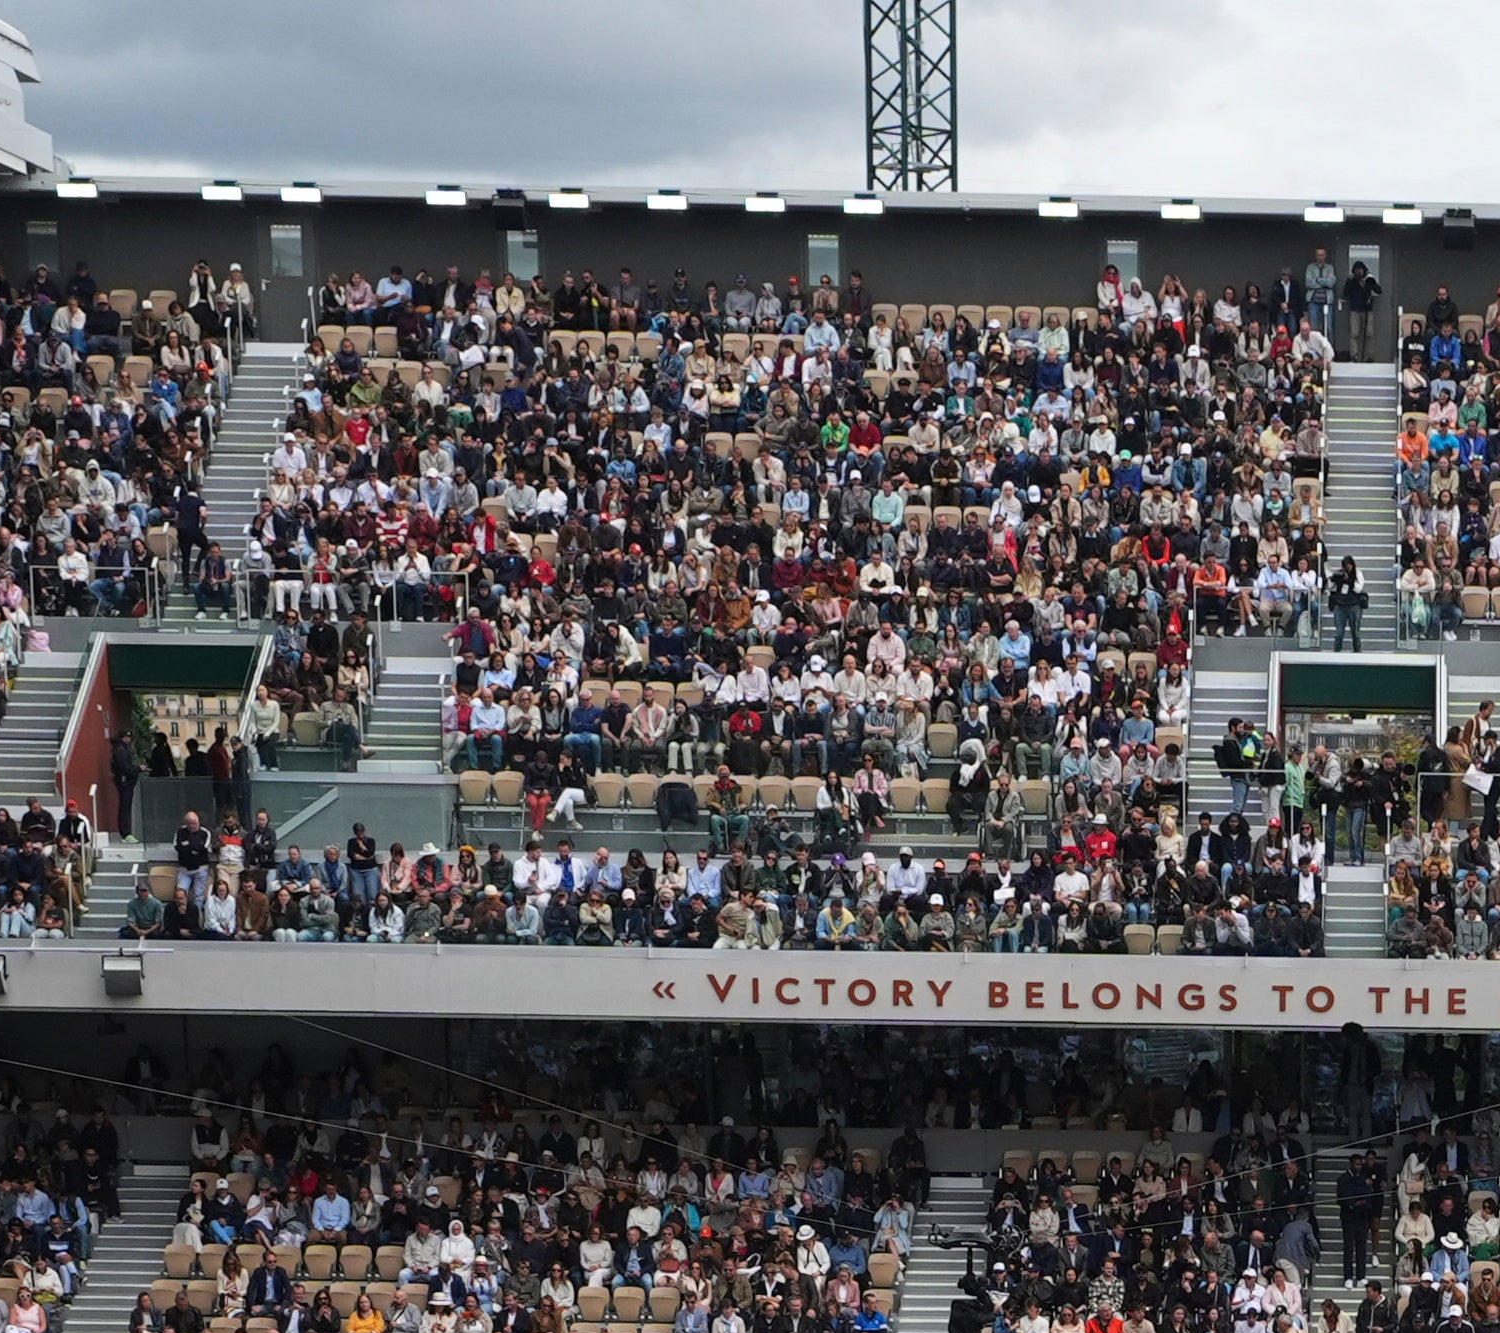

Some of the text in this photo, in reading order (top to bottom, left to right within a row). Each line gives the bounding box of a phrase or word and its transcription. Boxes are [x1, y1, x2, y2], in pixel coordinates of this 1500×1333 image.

[706, 974, 953, 1008] VICTORY
[988, 981, 1238, 1012] BELONGS
[1271, 984, 1336, 1014] TO
[1368, 987, 1468, 1016] THE
